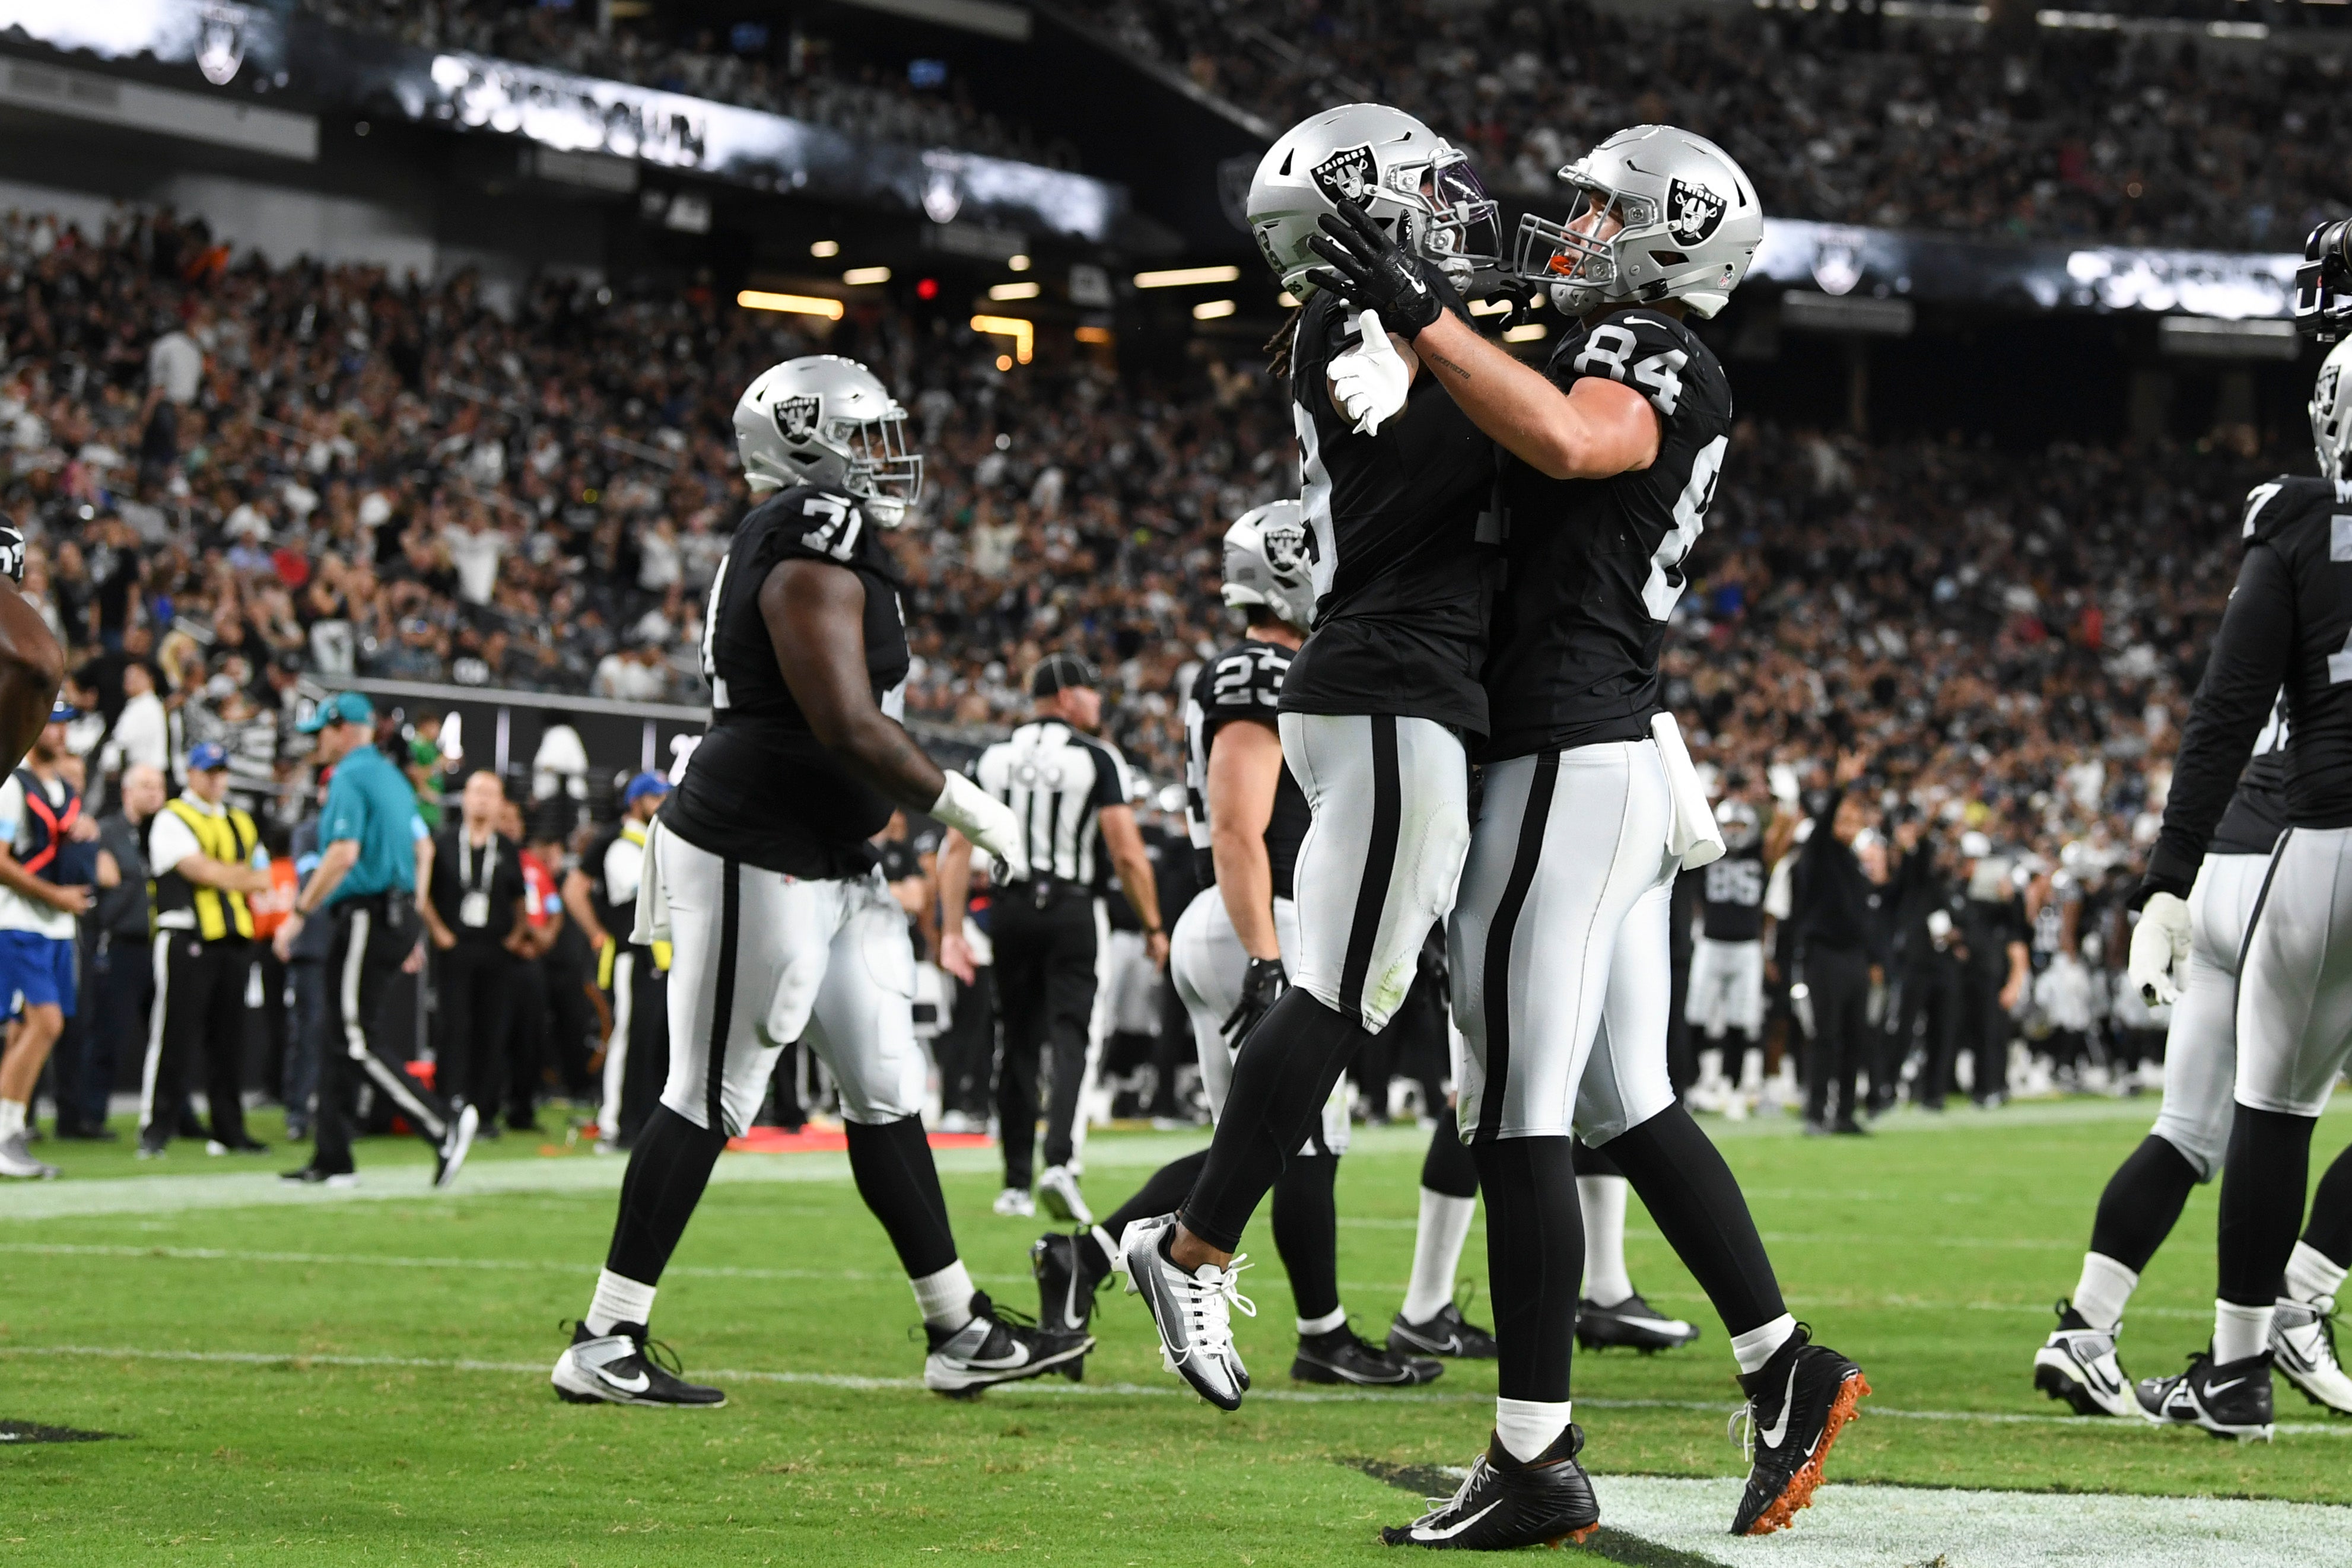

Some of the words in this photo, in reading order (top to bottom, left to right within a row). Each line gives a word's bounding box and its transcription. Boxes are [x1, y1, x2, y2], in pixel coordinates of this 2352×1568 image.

[1316, 148, 1366, 174] RAIDERS
[1676, 182, 1723, 206] RAIDERS
[1574, 325, 1689, 415] 84
[801, 498, 863, 561] 71
[1213, 655, 1292, 707] 23
